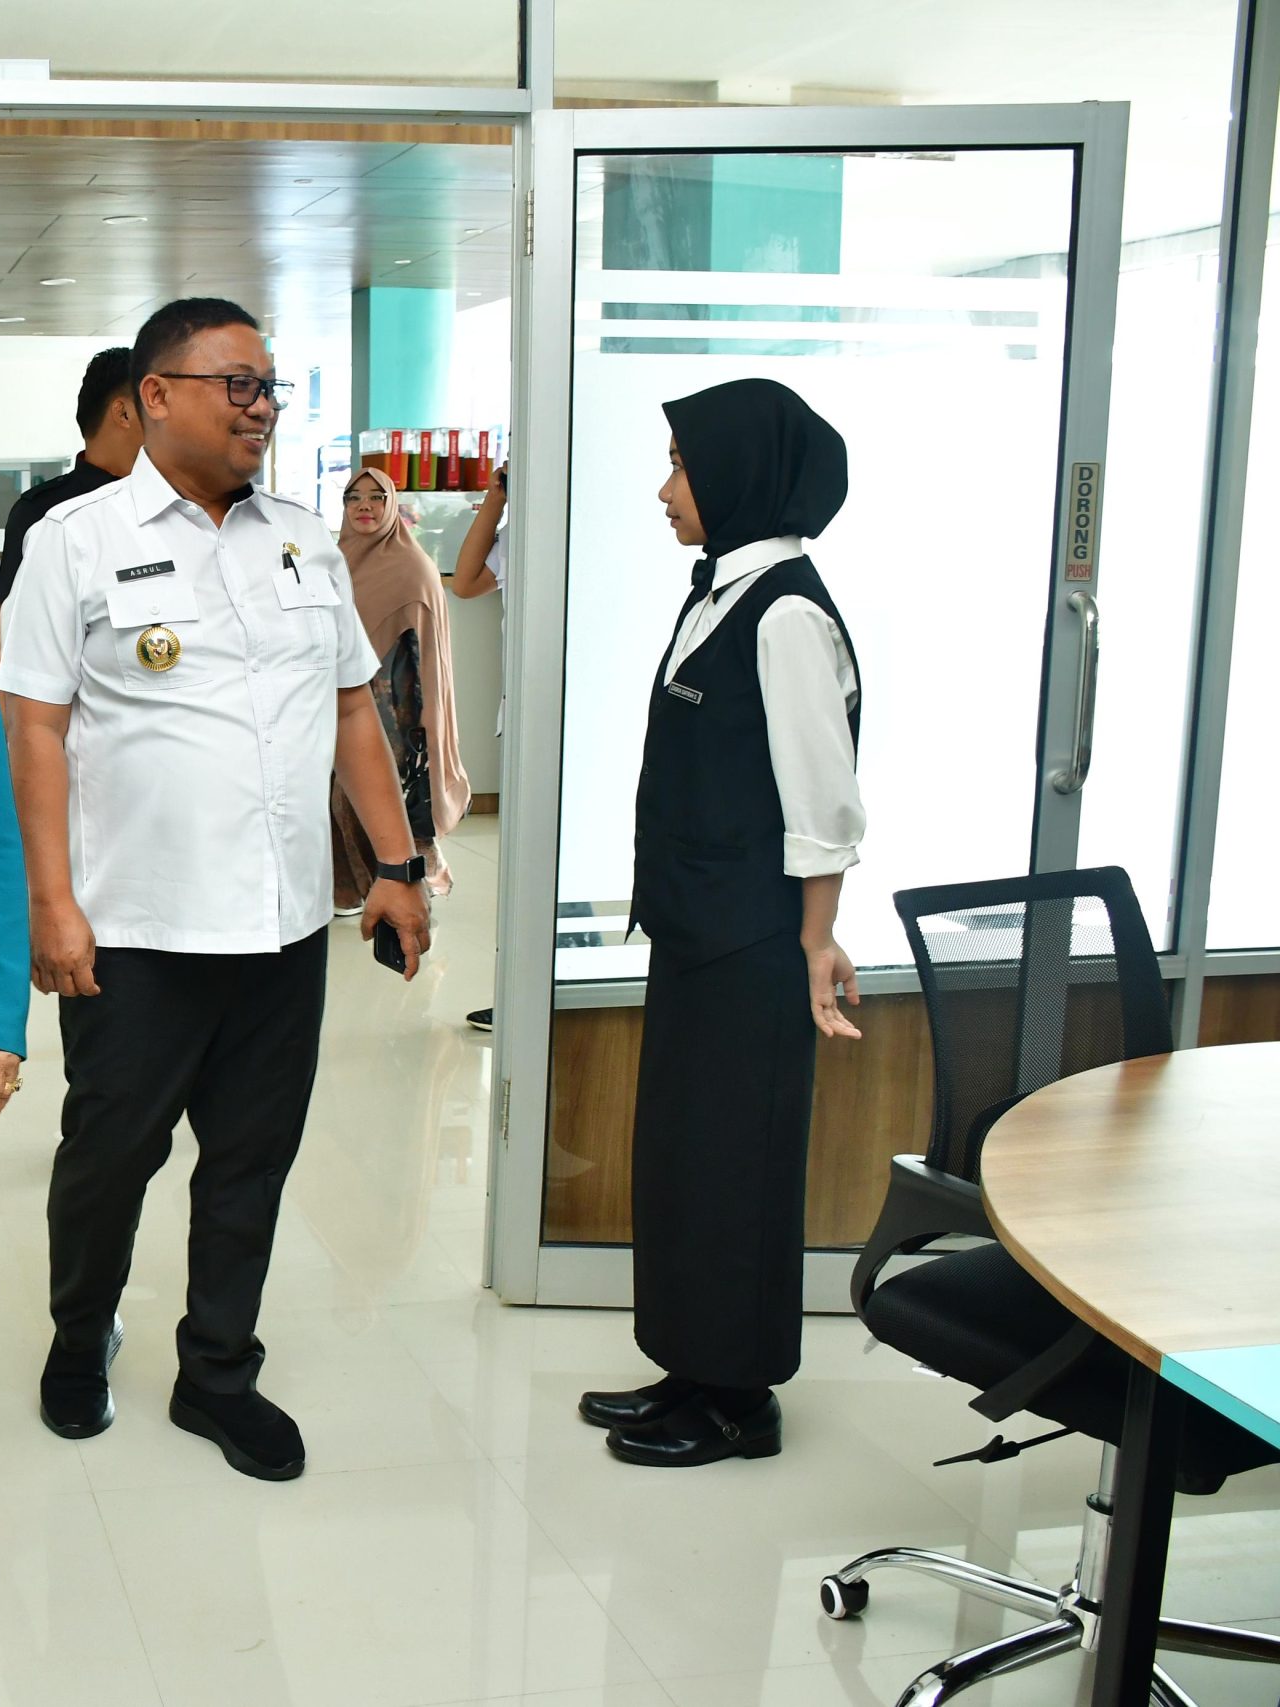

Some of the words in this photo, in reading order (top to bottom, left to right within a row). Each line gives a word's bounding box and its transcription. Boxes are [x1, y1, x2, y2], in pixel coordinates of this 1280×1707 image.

[1073, 466, 1093, 560] DORONG
[130, 565, 161, 576] ASRUL
[1067, 564, 1092, 578] PUSH
